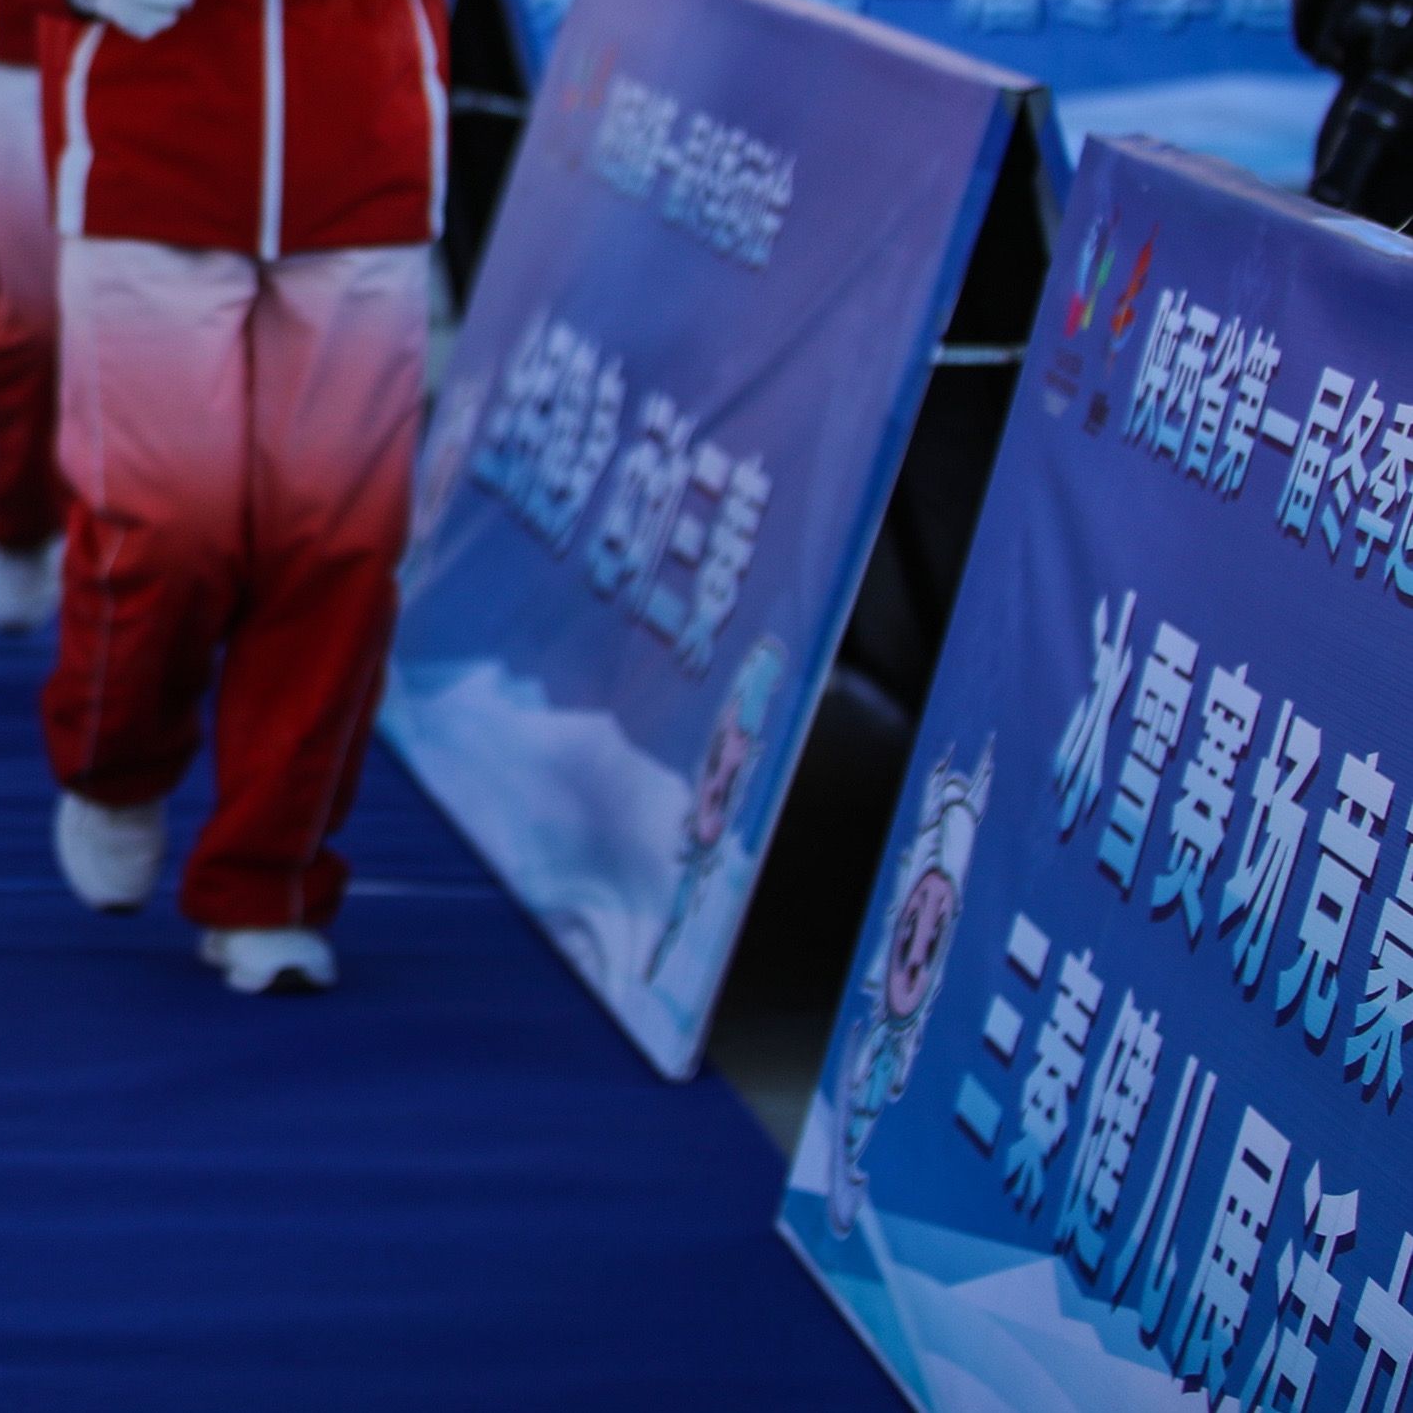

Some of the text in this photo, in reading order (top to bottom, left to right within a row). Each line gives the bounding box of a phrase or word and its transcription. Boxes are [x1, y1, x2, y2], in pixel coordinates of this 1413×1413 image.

[1123, 287, 1413, 598] 陕西省第一届冬季
